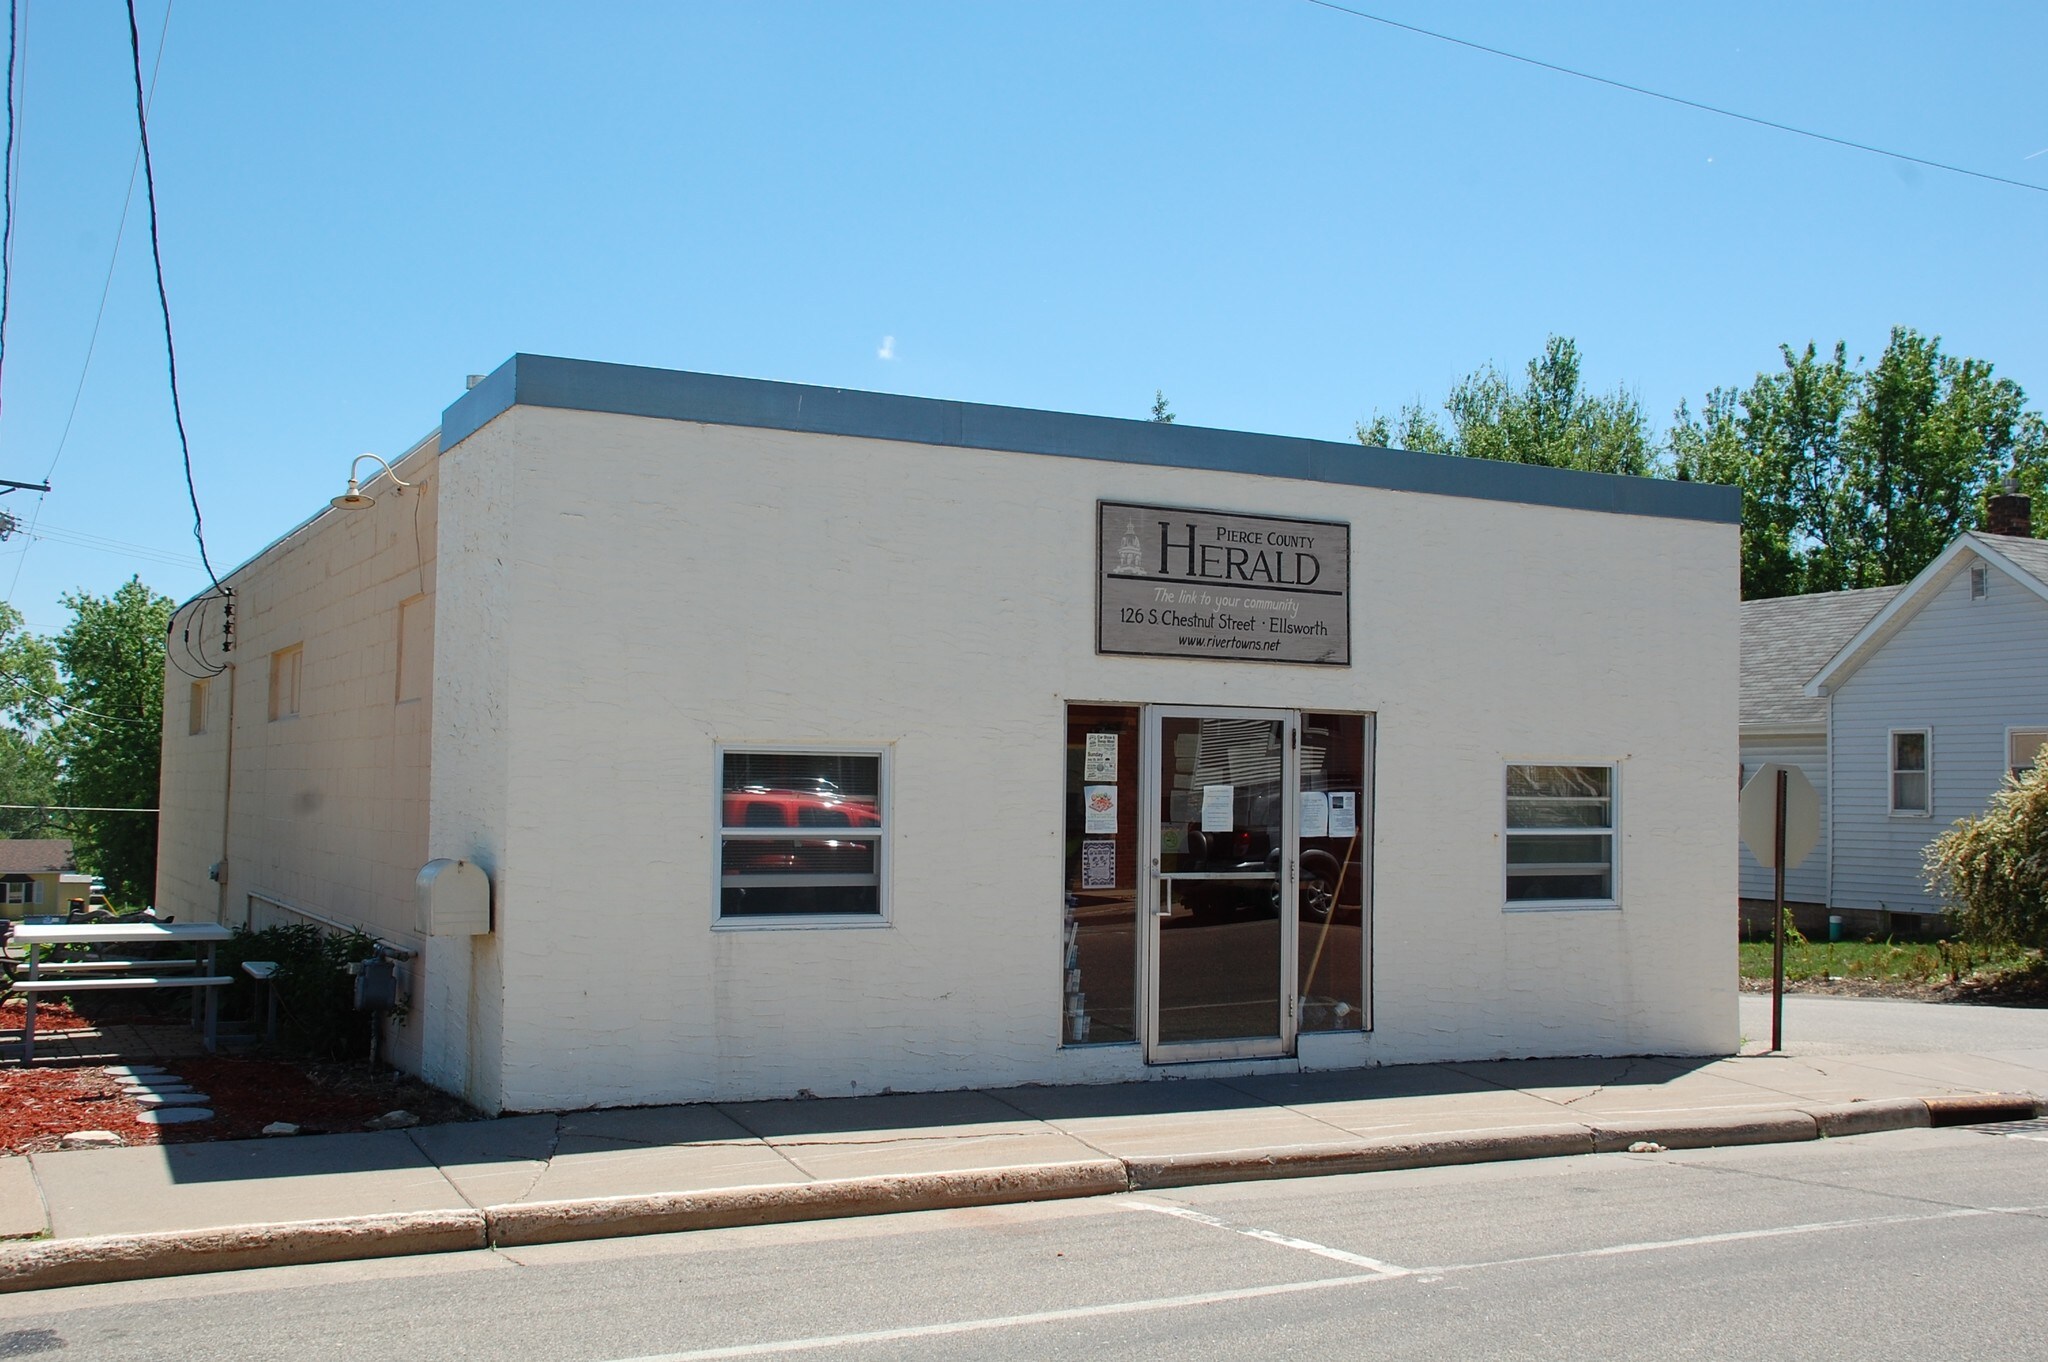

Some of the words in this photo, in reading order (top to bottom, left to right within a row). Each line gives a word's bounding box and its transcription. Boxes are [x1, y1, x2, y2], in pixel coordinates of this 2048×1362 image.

[1216, 526, 1263, 545] PIERCE
[1267, 532, 1315, 549] COUNTY
[1157, 520, 1321, 586] HERALD
[1154, 587, 1175, 603] The
[1178, 589, 1197, 604] link
[1200, 591, 1211, 605] to
[1213, 596, 1241, 613] your
[1243, 597, 1300, 619] community
[1120, 607, 1144, 624] 126
[1161, 610, 1216, 629] Chestnut
[1218, 613, 1256, 631] Street
[1269, 617, 1328, 636] Ellsworth
[1178, 635, 1281, 652] www.rivertowns.net
